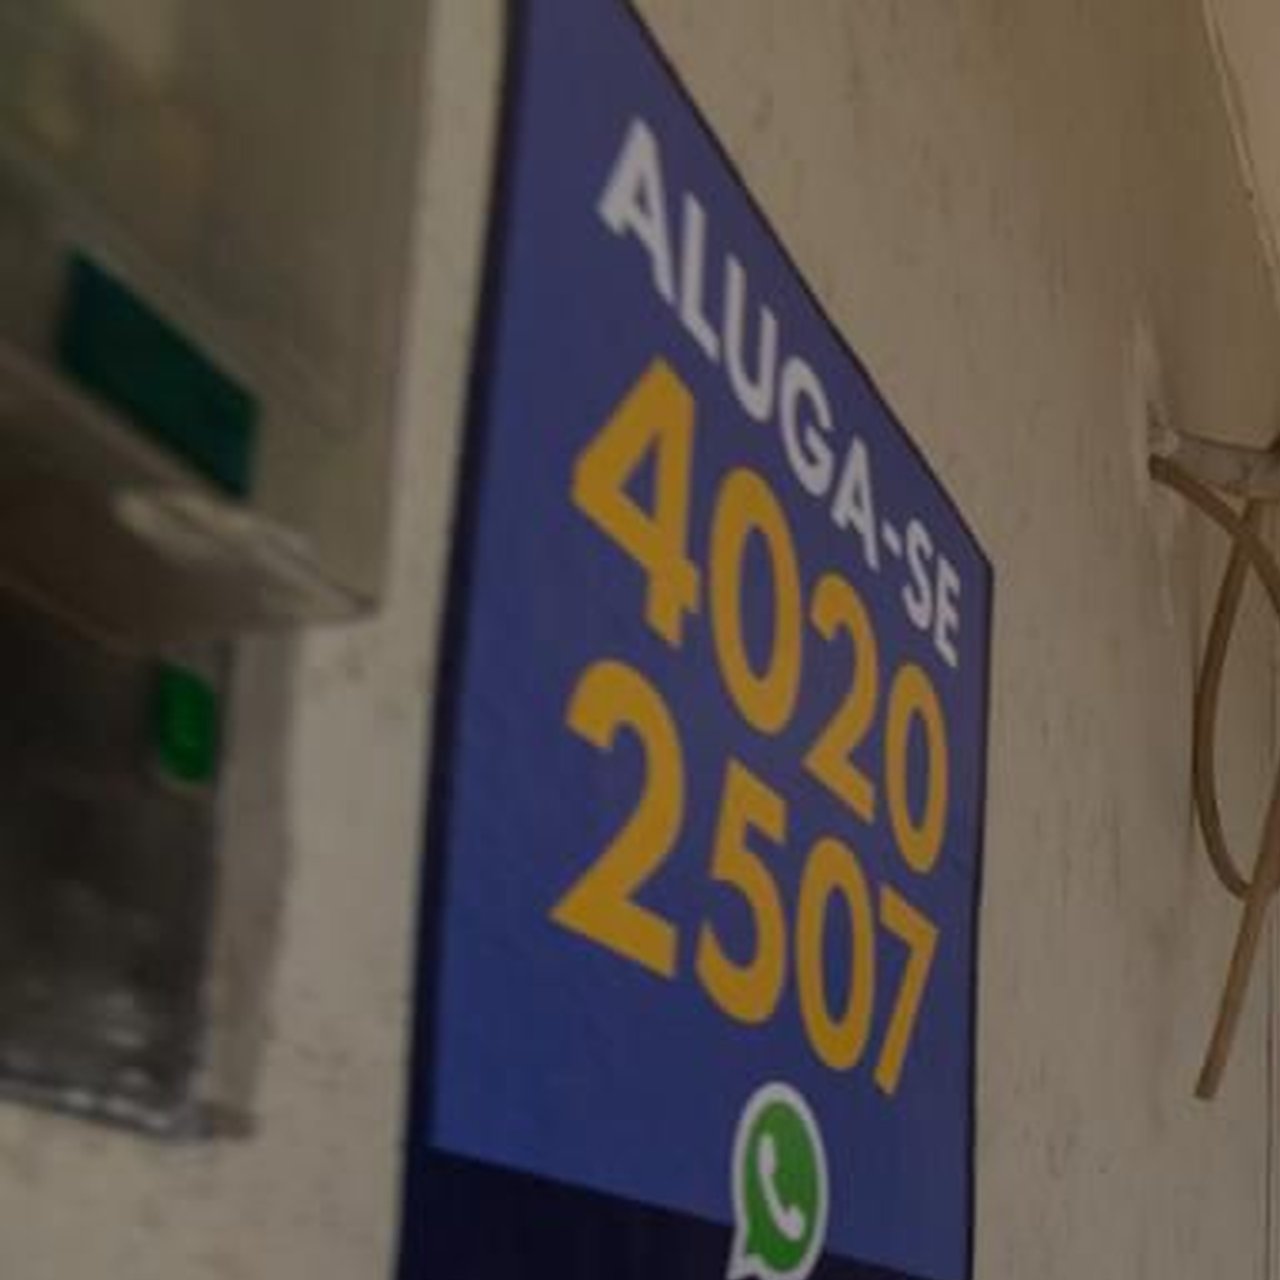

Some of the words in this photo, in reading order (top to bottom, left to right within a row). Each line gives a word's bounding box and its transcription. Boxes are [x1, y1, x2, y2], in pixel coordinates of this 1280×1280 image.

[571, 355, 950, 876] 4020
[599, 117, 960, 668] ALUGA-SE
[548, 658, 940, 1096] 2507
